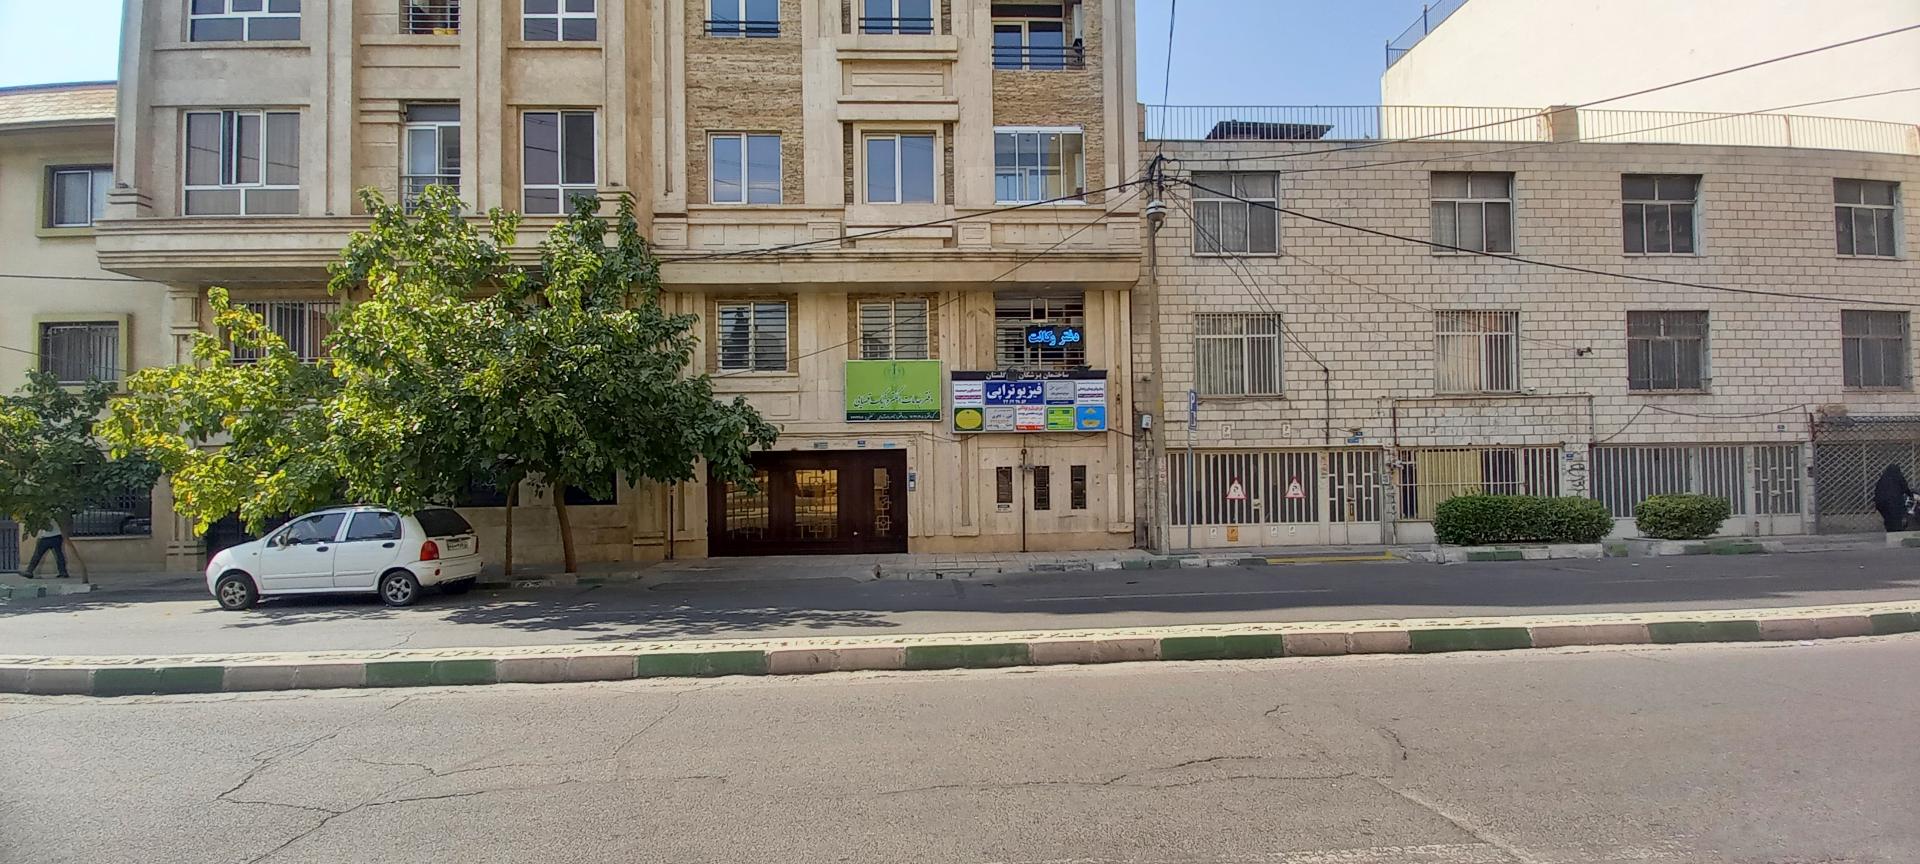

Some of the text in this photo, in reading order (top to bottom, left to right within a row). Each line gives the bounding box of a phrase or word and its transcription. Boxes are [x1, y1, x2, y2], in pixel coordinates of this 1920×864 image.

[1028, 329, 1080, 346] دفتر وکالت
[1018, 370, 1042, 380] پزشکان
[1043, 370, 1070, 380] ساختمان
[919, 389, 934, 405] دفتر
[986, 382, 1043, 400] فیزیوتراپی
